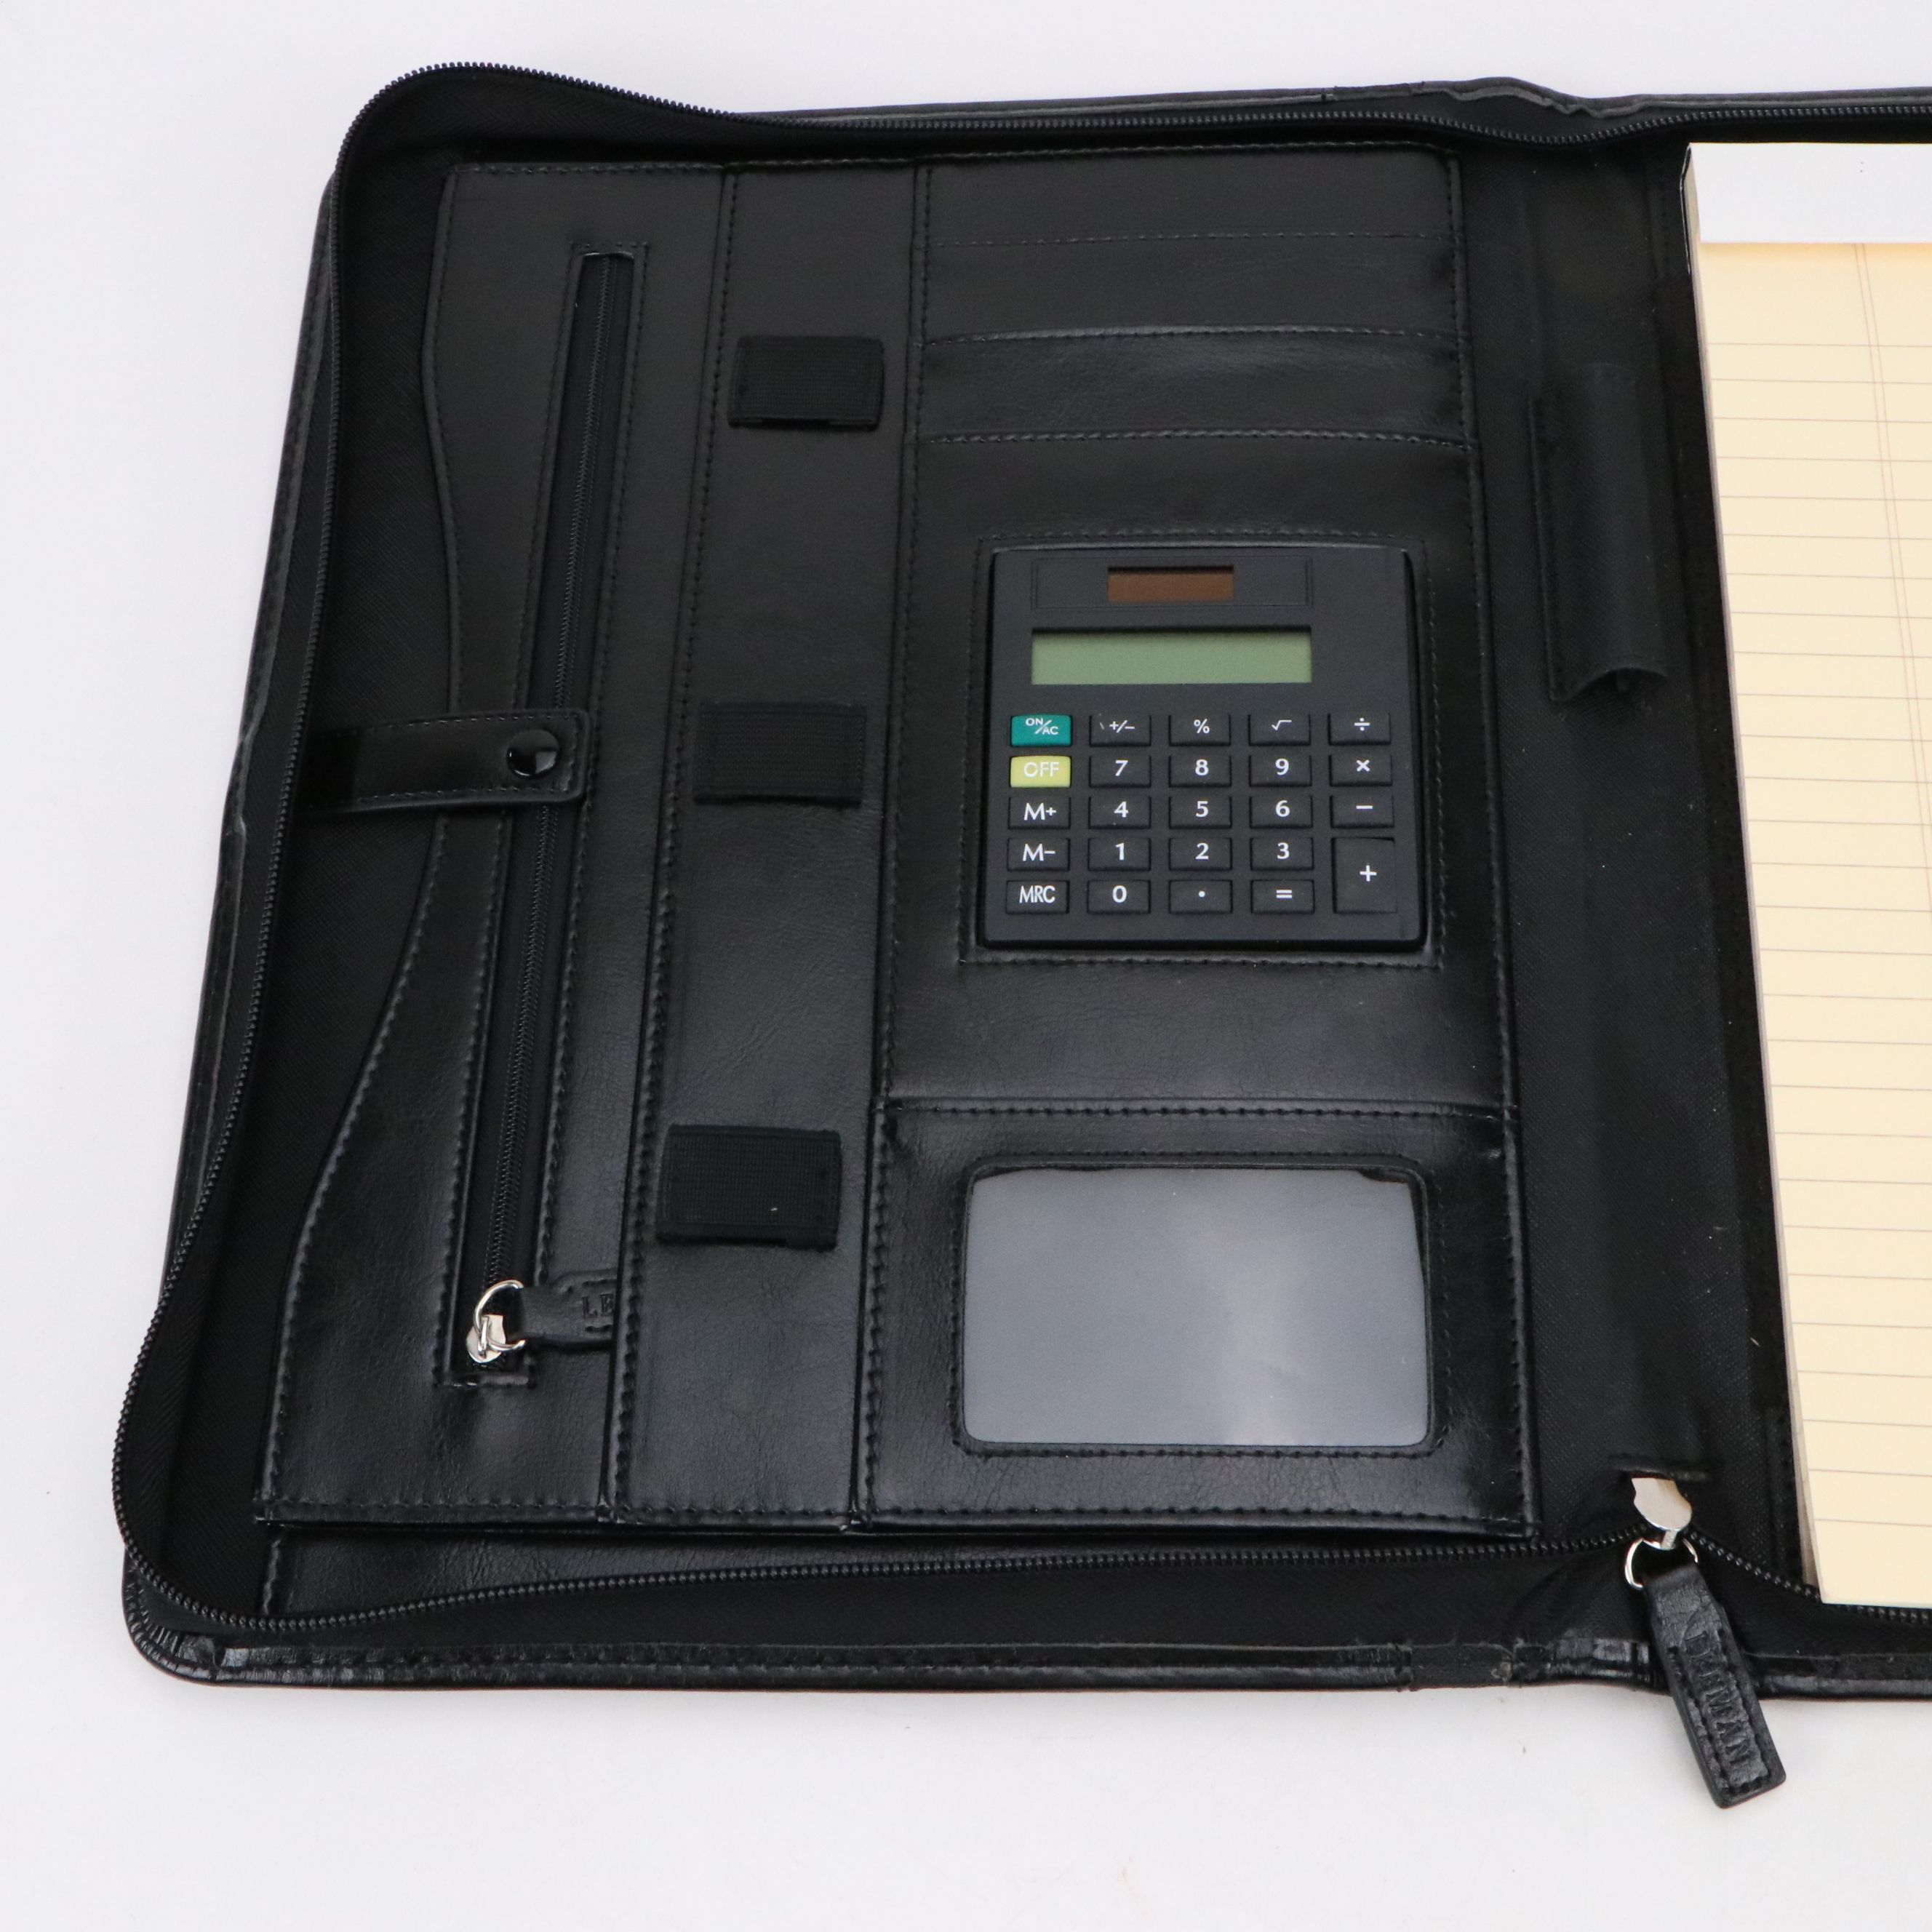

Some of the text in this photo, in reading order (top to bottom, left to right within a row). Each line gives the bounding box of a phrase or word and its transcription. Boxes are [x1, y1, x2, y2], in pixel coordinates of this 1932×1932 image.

[1193, 718, 1210, 734] %
[1023, 761, 1060, 778] OFF
[1115, 759, 1128, 777] 7
[1194, 759, 1209, 776] 8
[1275, 758, 1290, 775] 9
[1023, 802, 1057, 821] M+
[1114, 801, 1129, 818] 4
[1195, 800, 1209, 818] 5
[1275, 799, 1290, 818] 6
[1022, 843, 1055, 861] M-
[1115, 842, 1125, 861] 1
[1195, 842, 1209, 860] 2
[1277, 842, 1290, 860] 3
[1019, 885, 1055, 903] MRC
[1112, 885, 1127, 903] 0
